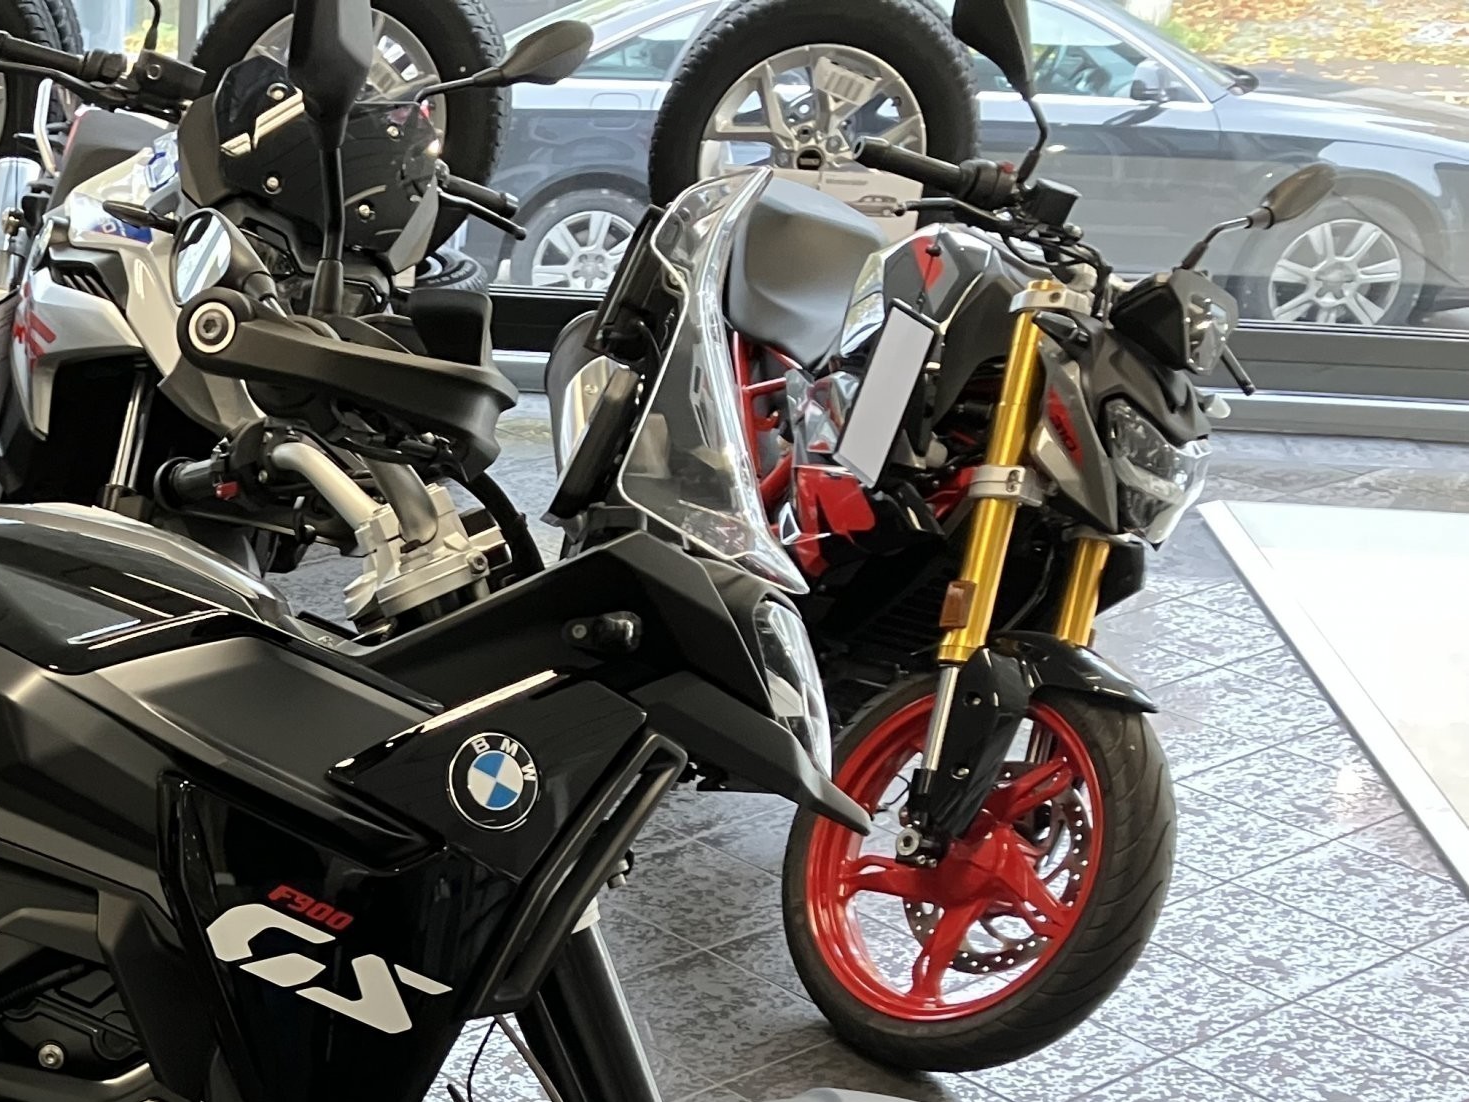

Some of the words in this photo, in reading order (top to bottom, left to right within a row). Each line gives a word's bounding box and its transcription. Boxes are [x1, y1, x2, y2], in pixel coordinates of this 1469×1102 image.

[470, 736, 538, 782] BMW
[267, 884, 354, 931] F900
[206, 903, 453, 1034] GS
